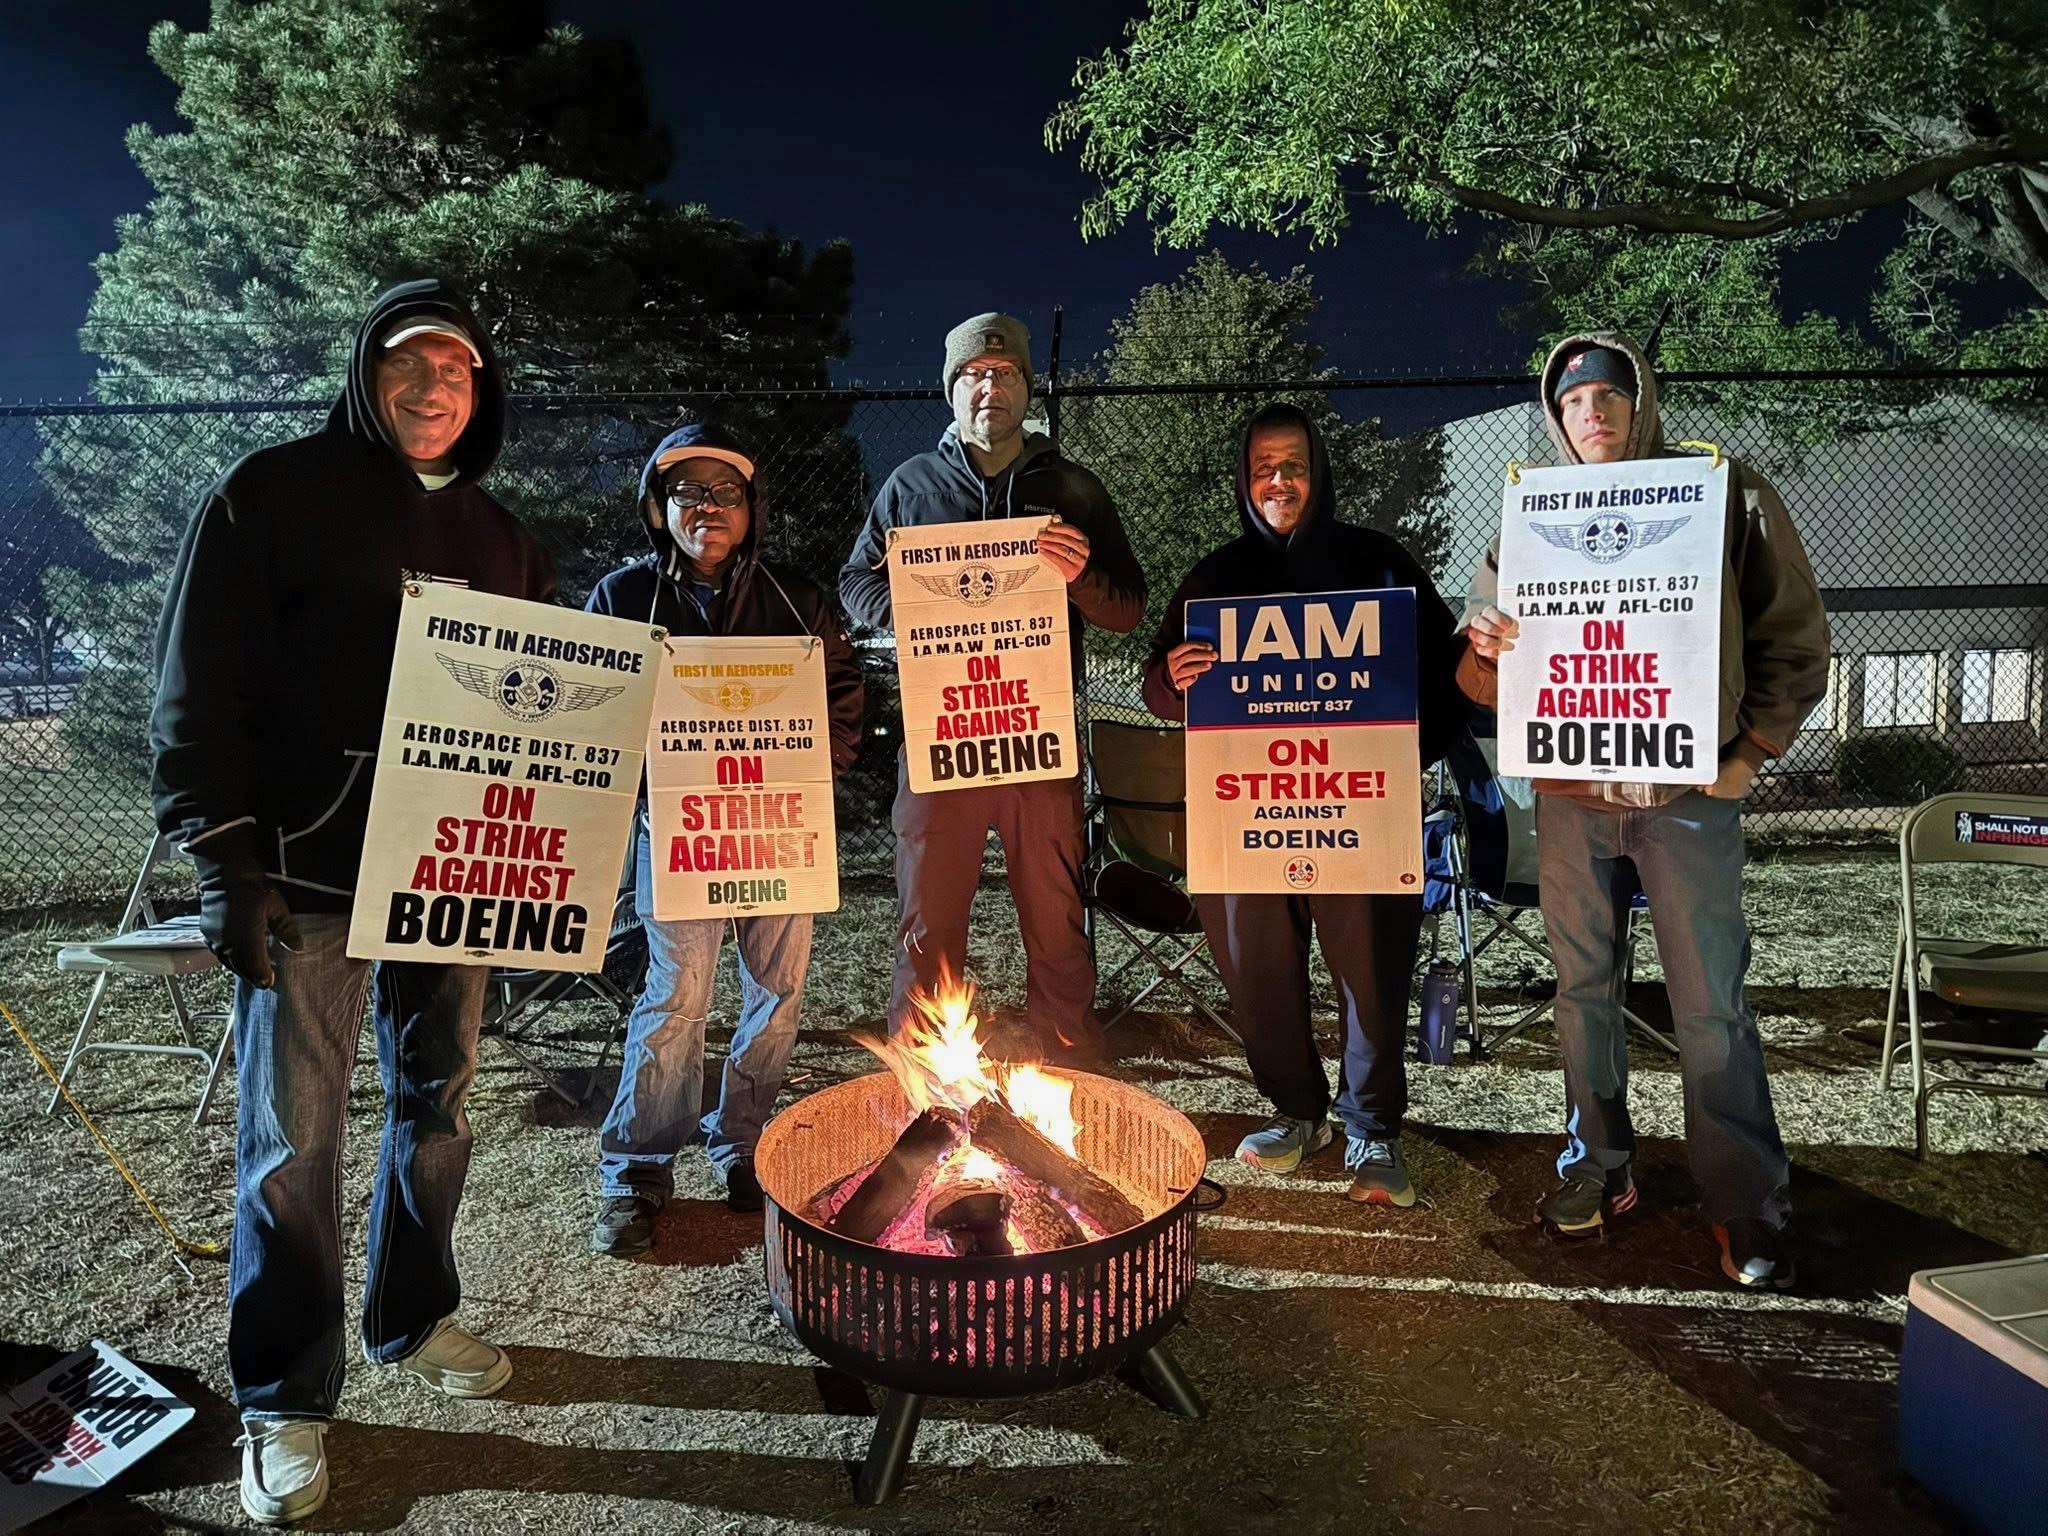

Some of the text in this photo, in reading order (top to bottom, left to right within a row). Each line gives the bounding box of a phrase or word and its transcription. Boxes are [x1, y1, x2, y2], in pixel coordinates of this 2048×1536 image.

[1522, 484, 1704, 513] FIRST IN AEROSPACE
[901, 539, 1039, 565] FIRST IN AEROSPAC
[1516, 575, 1699, 597] AEROSPACE DIST. 837
[1618, 597, 1693, 614] AFL-CIO
[910, 616, 1053, 641] AEROSPACE DIST. 837
[994, 633, 1051, 650] AFL-CIO
[1219, 600, 1381, 663] IAM
[1583, 620, 1624, 651] ON
[427, 616, 643, 675] FIRST IN AEROSPACE
[673, 664, 795, 678] FIRST IN AEROSPACE
[967, 655, 1001, 682] ON
[1231, 671, 1370, 694] UNION
[1549, 653, 1658, 685] STRIKE
[943, 679, 1030, 712] STRIKE
[1247, 699, 1353, 714] DISTRICT 837
[1536, 688, 1672, 719] AGAINST
[661, 719, 813, 733] AEROSPACE DIST. 837
[936, 706, 1040, 741] AGAINST
[402, 722, 620, 766] AEROSPACE DIST. 837
[753, 736, 813, 750] AFL-CIO
[929, 732, 1062, 782] BOEING
[1268, 738, 1330, 766] ON
[1526, 721, 1694, 770] BOEING
[525, 763, 611, 788] AFL-CIO
[717, 755, 763, 791] ON
[1215, 771, 1386, 801] STRIKE!
[482, 783, 535, 822] ON
[681, 792, 804, 831] STRIKE
[1254, 805, 1346, 820] AGAINST
[434, 816, 568, 863] STRIKE
[1243, 829, 1359, 849] BOEING
[1975, 822, 2048, 835] SHALL NOT B
[1975, 832, 2048, 845] INFRINGE
[668, 832, 818, 872] AGAINST
[410, 855, 575, 902] AGAINST
[708, 879, 787, 904] BOEING
[384, 892, 588, 955] BOEING
[47, 1354, 171, 1449] BOEING
